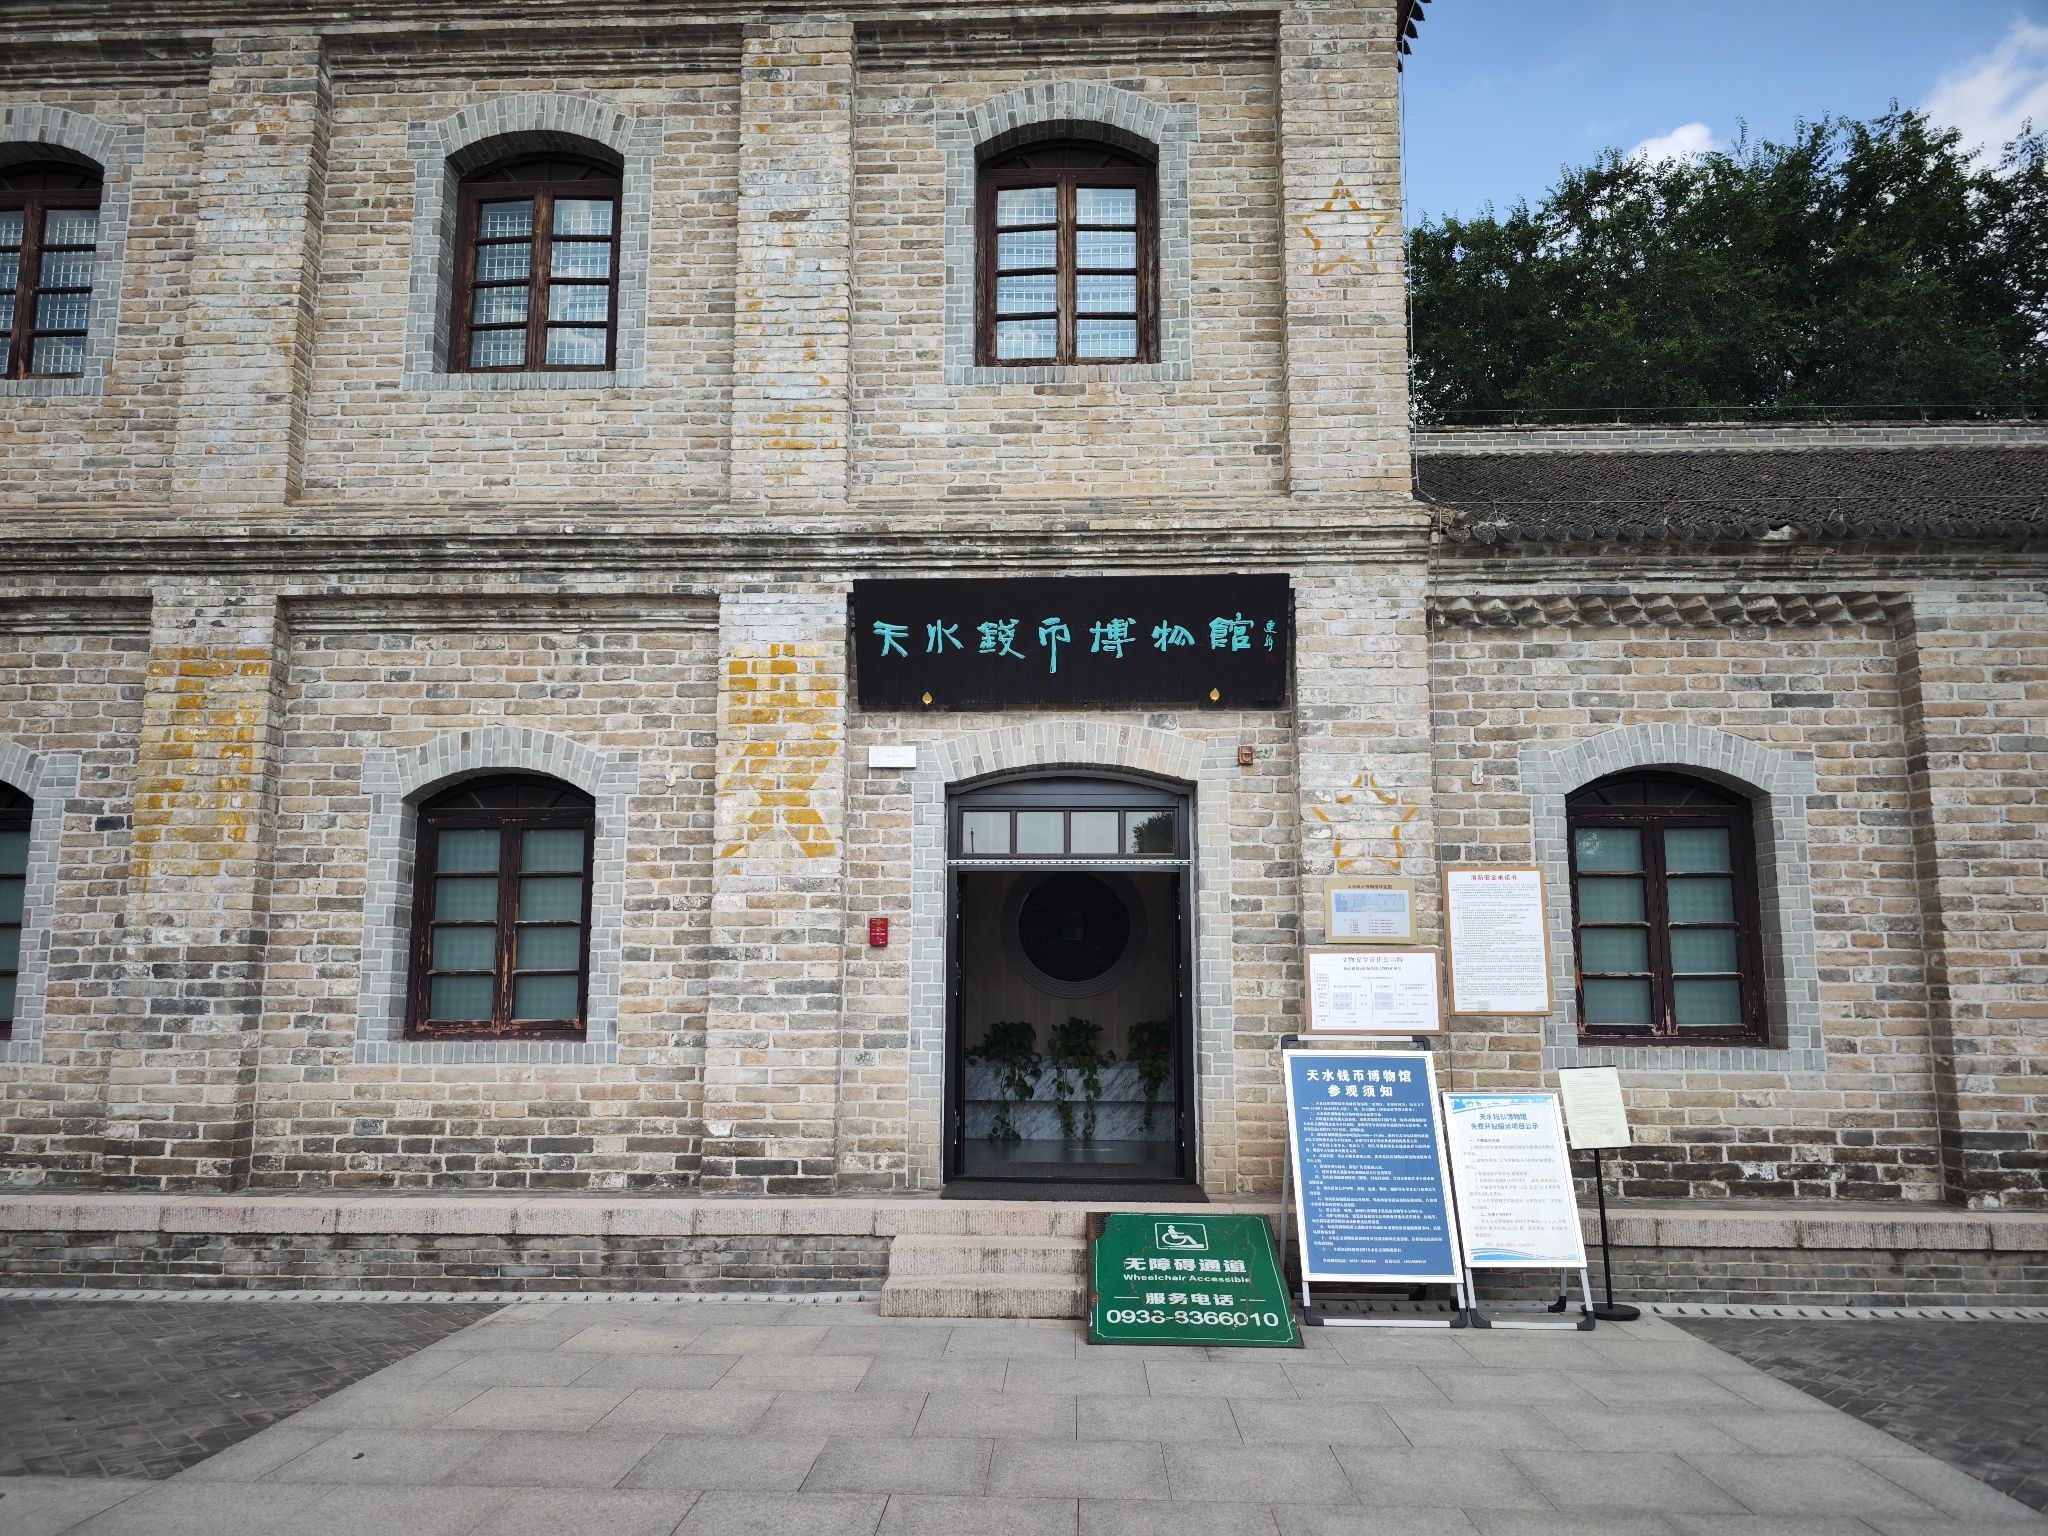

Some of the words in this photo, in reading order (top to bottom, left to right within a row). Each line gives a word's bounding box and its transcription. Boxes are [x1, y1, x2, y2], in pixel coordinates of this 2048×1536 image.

[1306, 1069, 1412, 1083] 天水钱币博物馆
[1327, 1084, 1394, 1098] 参观须知
[1123, 1257, 1248, 1273] 无障碍通道
[1123, 1274, 1187, 1282] Wheelchair
[1188, 1275, 1251, 1283] Accessible
[1145, 1292, 1235, 1306] 服务电话
